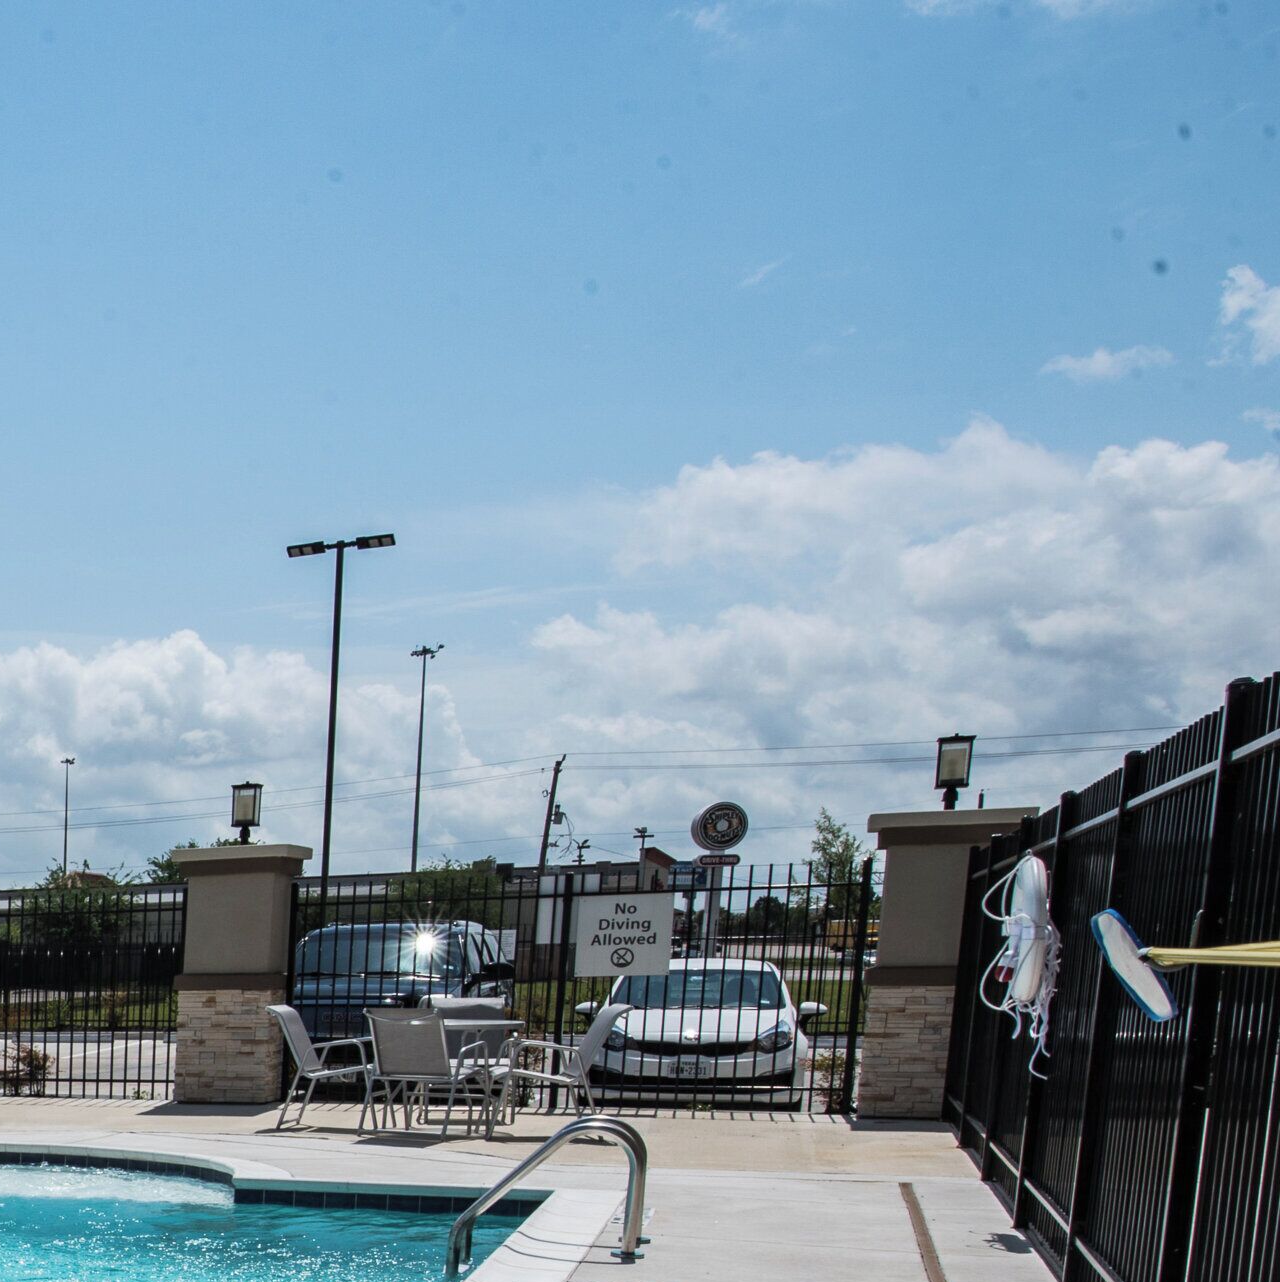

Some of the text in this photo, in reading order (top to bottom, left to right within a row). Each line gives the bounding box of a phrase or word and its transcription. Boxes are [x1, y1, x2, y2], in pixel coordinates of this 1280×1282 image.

[614, 902, 637, 915] No
[598, 918, 651, 932] Diving
[590, 932, 657, 946] Allowed
